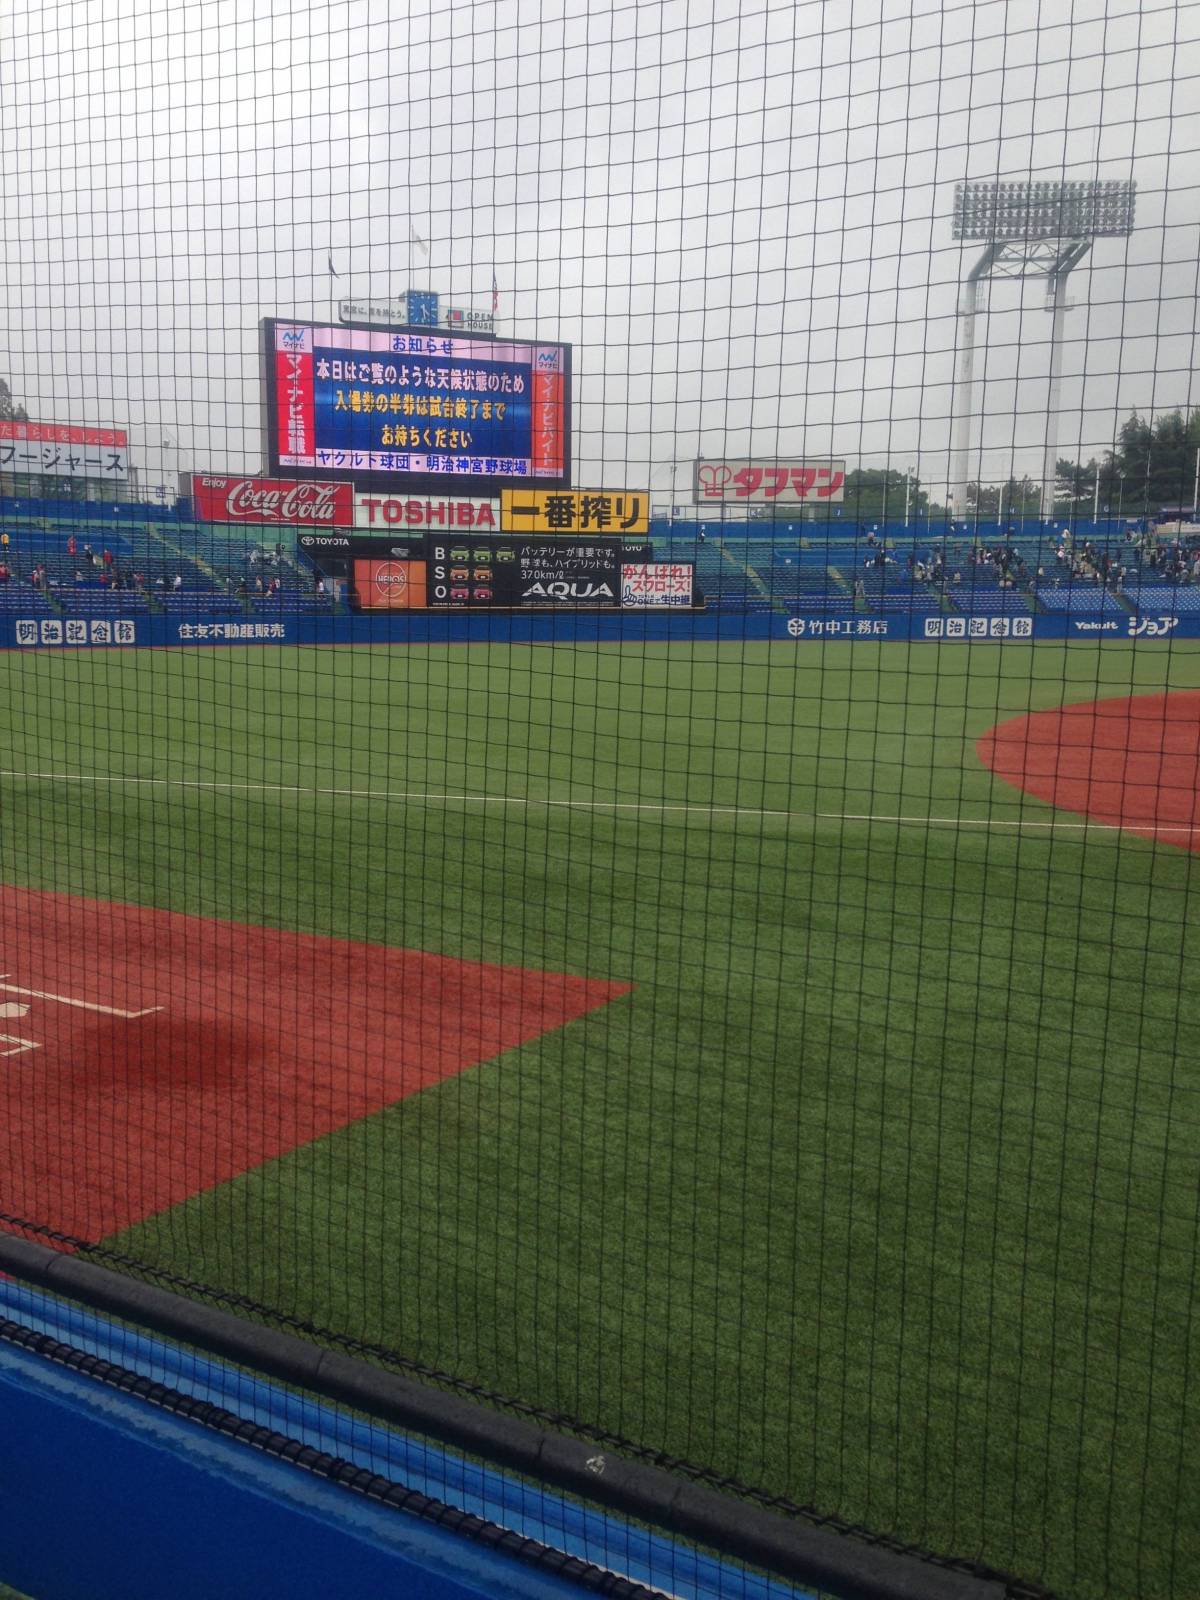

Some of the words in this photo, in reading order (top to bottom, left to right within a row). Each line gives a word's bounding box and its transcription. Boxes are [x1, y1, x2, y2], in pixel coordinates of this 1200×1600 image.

[467, 312, 494, 321] OPEN
[467, 321, 494, 330] HOUSE
[392, 335, 454, 354] お知らせ
[316, 357, 525, 394] 本日はご覧のような天候状態のため
[286, 353, 306, 454] マイナビ転職
[335, 389, 507, 421] 入場券の半券は試合終了まで
[381, 424, 473, 449] お持ちください
[0, 446, 124, 471] フージャース
[317, 451, 528, 475] ヤクルト球団・明治神宮野球場
[202, 477, 227, 488] Enjoy
[733, 467, 844, 497] タフマン
[226, 481, 340, 519] Coca-Cola
[361, 499, 496, 526] TOSHIBA
[511, 495, 640, 529] 一番搾り
[316, 537, 349, 546] TOYOTA
[435, 547, 445, 560] B
[521, 546, 615, 558] バッテリーが重要です。
[435, 566, 445, 579] S
[435, 585, 447, 598] O
[521, 582, 615, 600] AQUA
[17, 622, 134, 643] 明治記念館
[178, 623, 285, 639] 住友不動産販売
[808, 620, 888, 635] 竹中工務店
[927, 619, 1031, 636] 明治記念館
[1075, 621, 1119, 630] Yakult
[1128, 616, 1178, 636] ジョア
